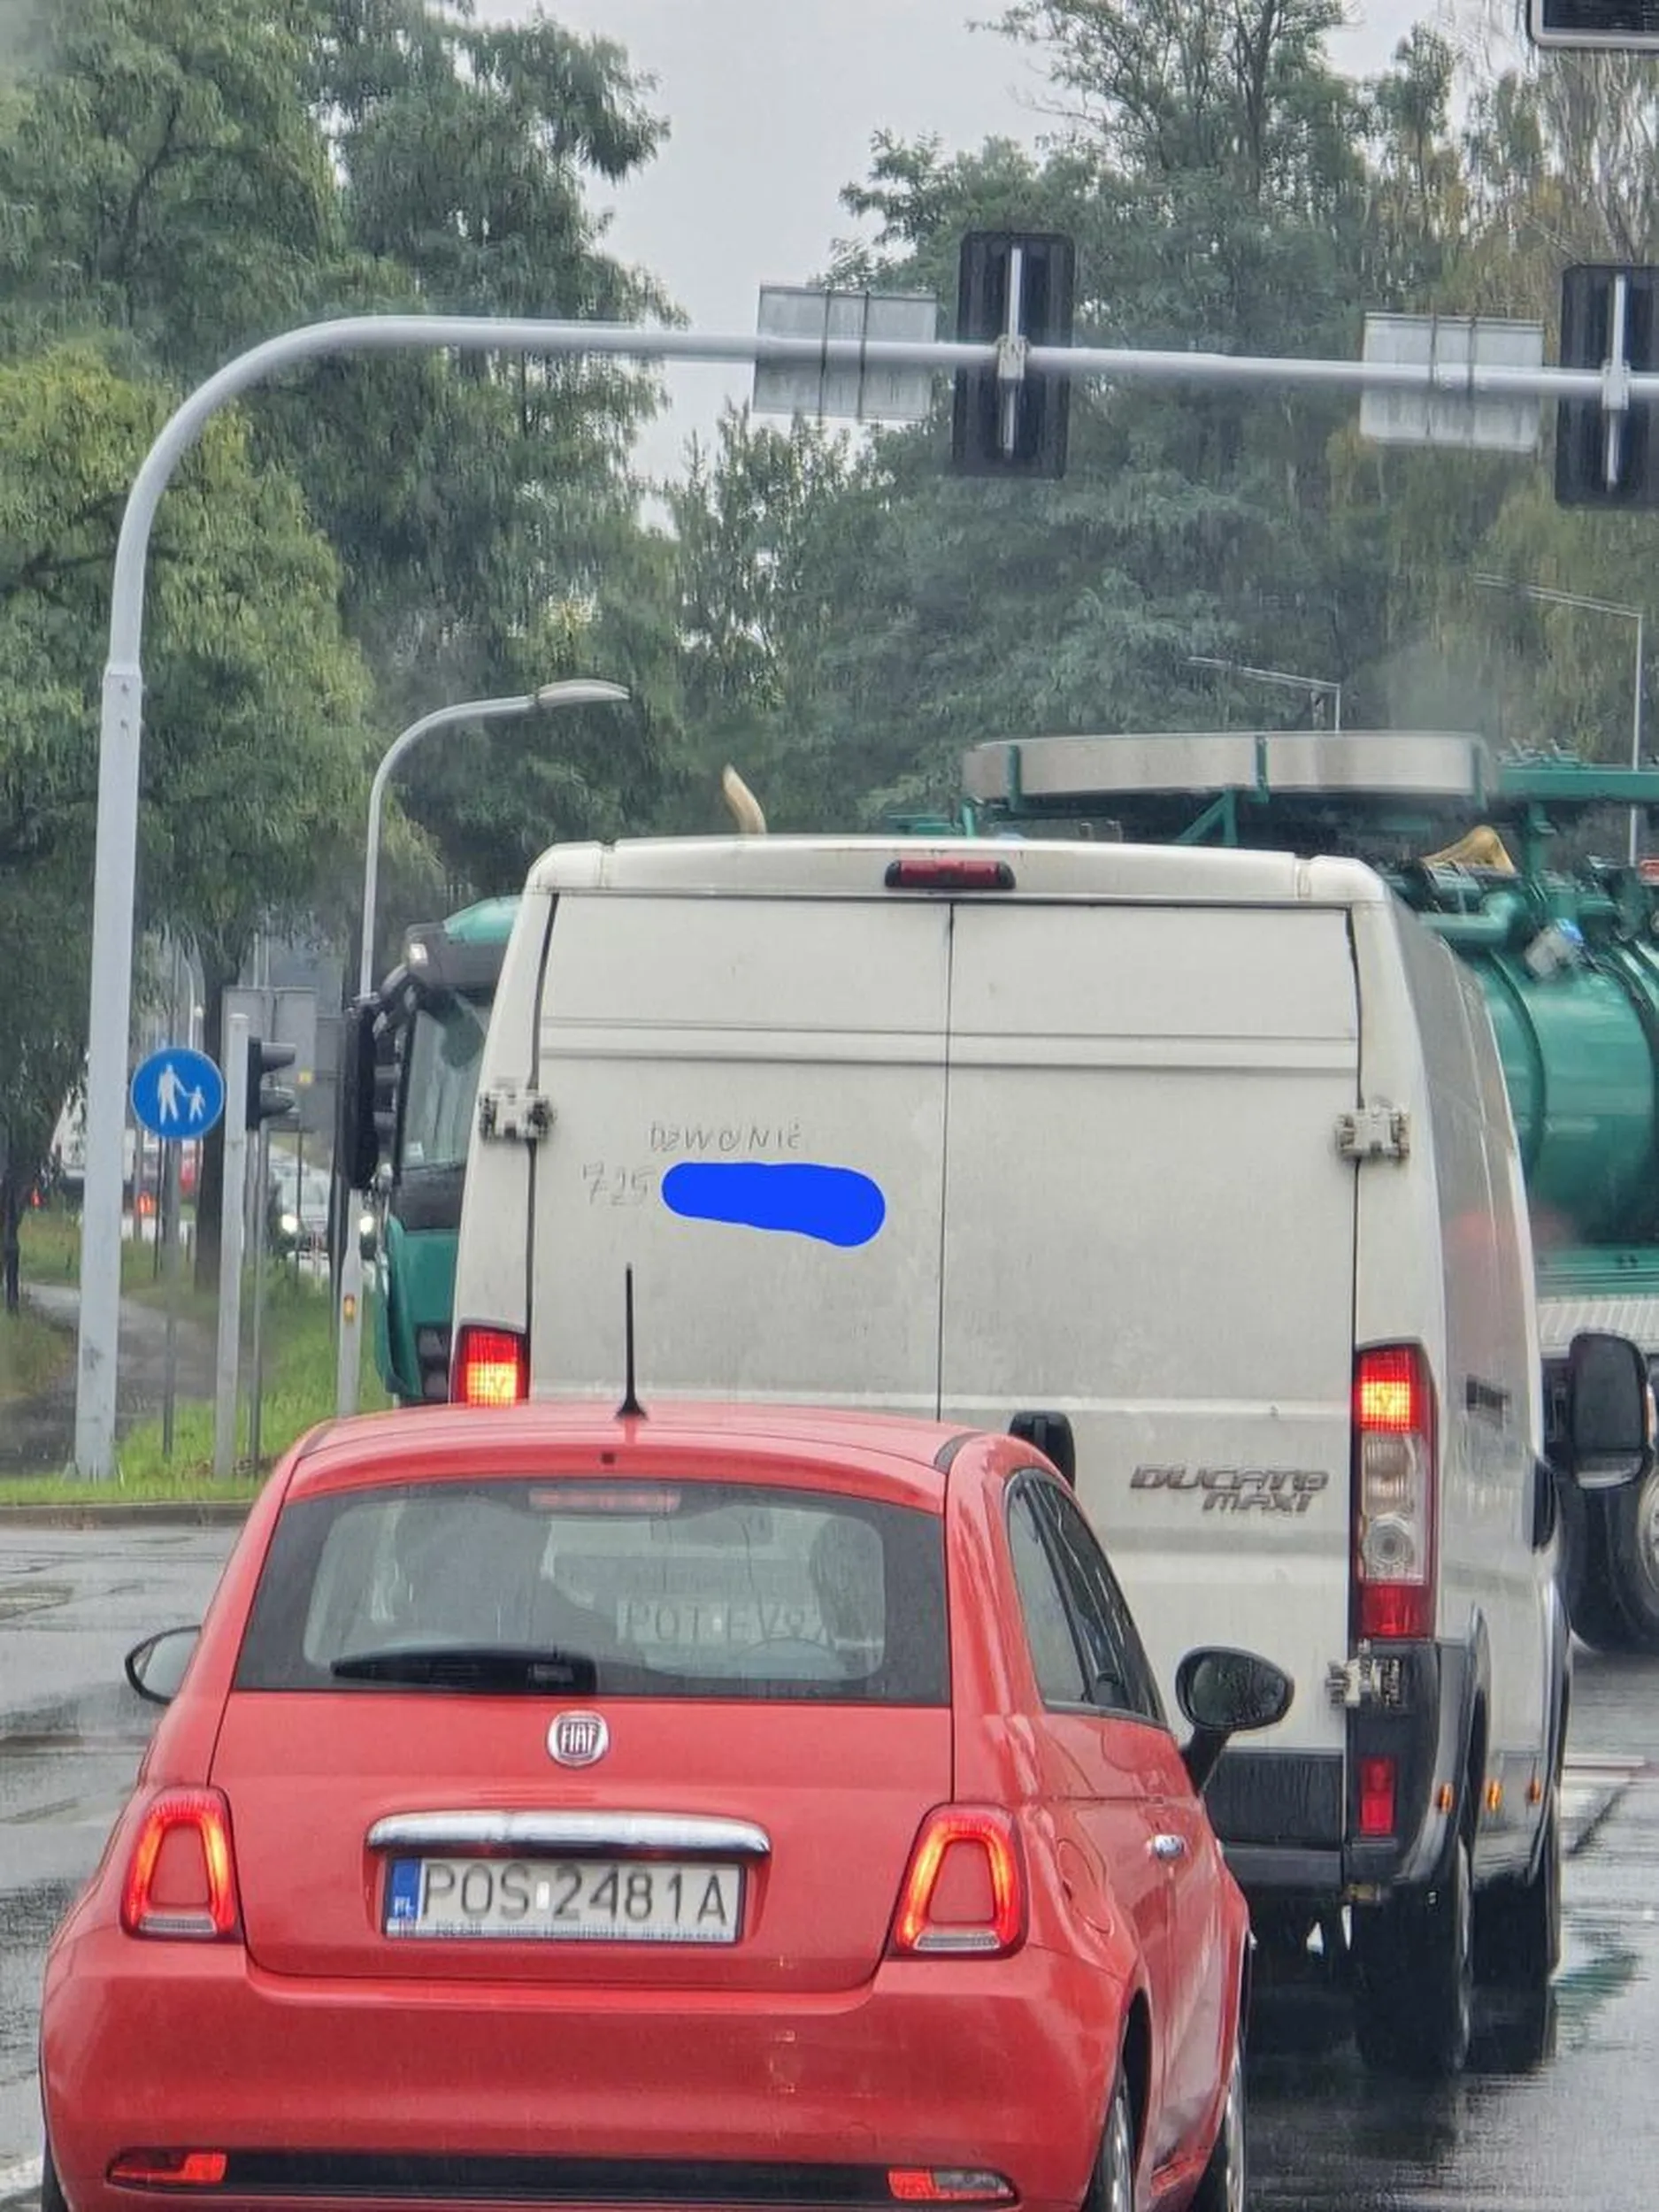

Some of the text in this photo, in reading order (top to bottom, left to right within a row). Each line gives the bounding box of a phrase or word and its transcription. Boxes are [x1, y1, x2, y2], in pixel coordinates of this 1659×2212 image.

[1129, 1465, 1329, 1491] DUCATO
[1202, 1491, 1314, 1512] MAXI
[560, 1723, 599, 1753] FIAT
[421, 1863, 729, 1925] POS 2481A
